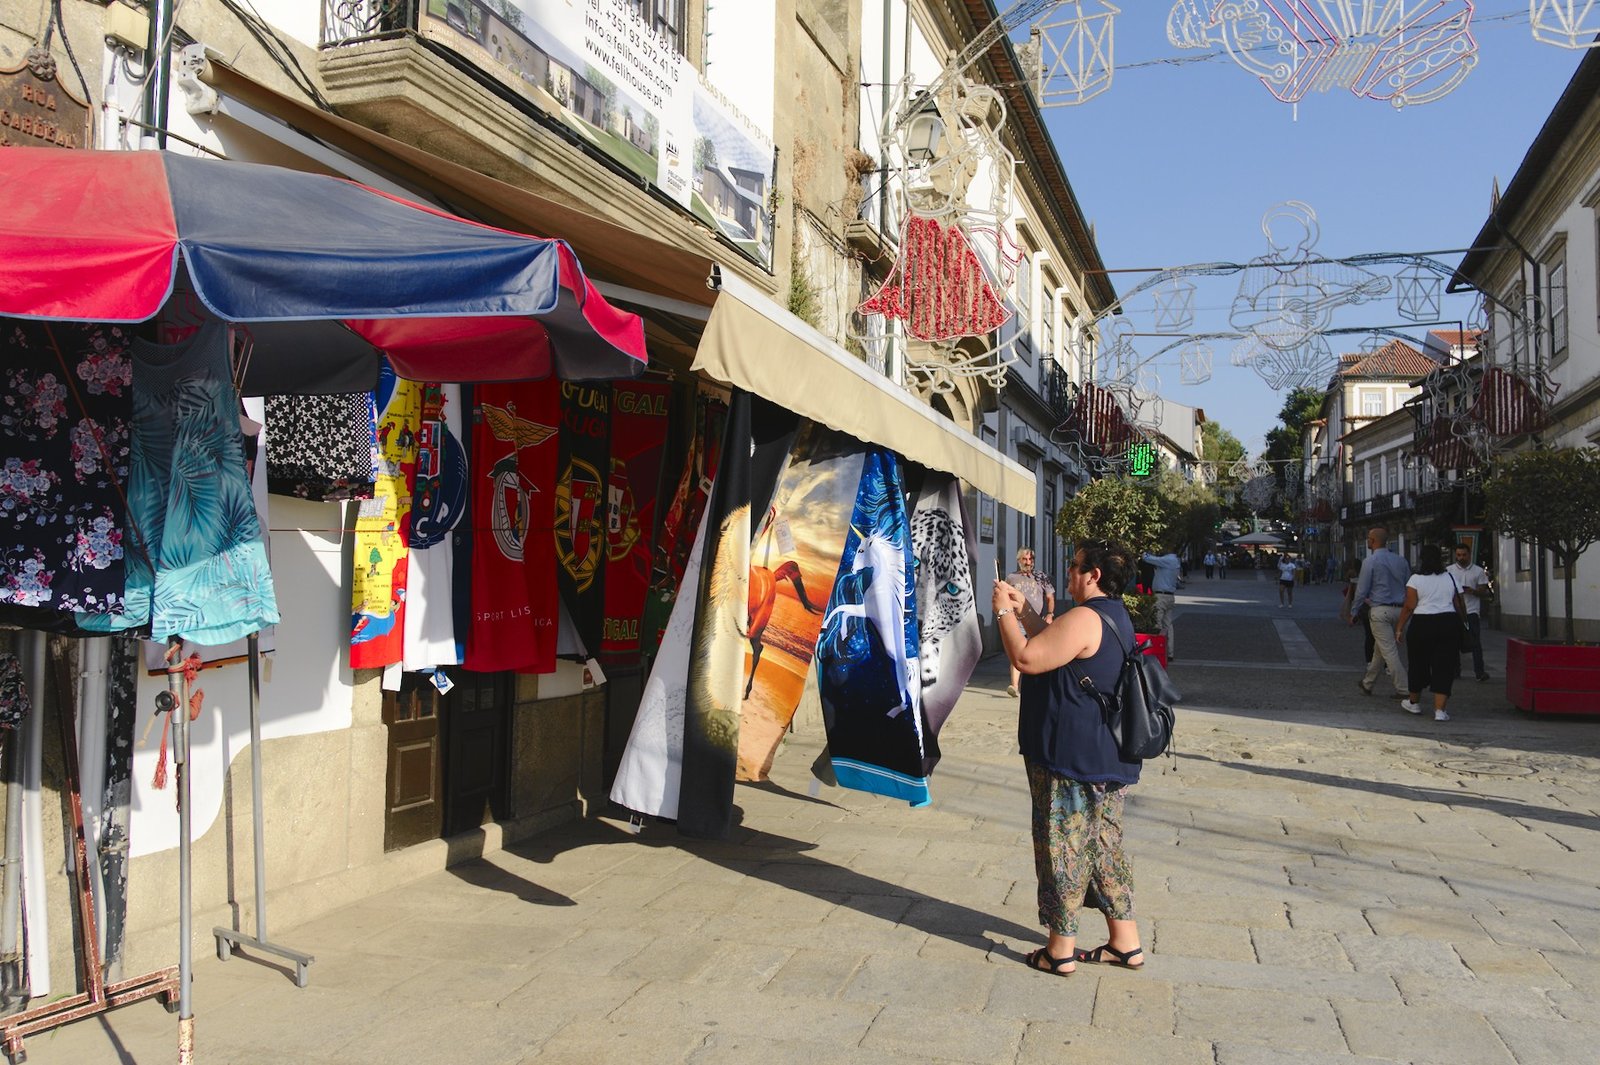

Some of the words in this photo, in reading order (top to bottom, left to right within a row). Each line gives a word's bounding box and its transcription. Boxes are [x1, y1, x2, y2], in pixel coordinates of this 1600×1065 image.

[585, 11, 673, 97] info@felihouse.com
[606, 10, 627, 36] +351
[629, 29, 640, 48] 93
[642, 41, 658, 64] 572
[660, 58, 669, 74] 41
[671, 66, 679, 83] 15
[630, 9, 641, 28] 96
[643, 20, 657, 41] 137
[659, 37, 670, 55] 82
[671, 48, 682, 65] 69
[22, 83, 57, 112] RUA
[585, 36, 664, 109] www.felihouse.pt
[0, 108, 75, 149] CARDEAL
